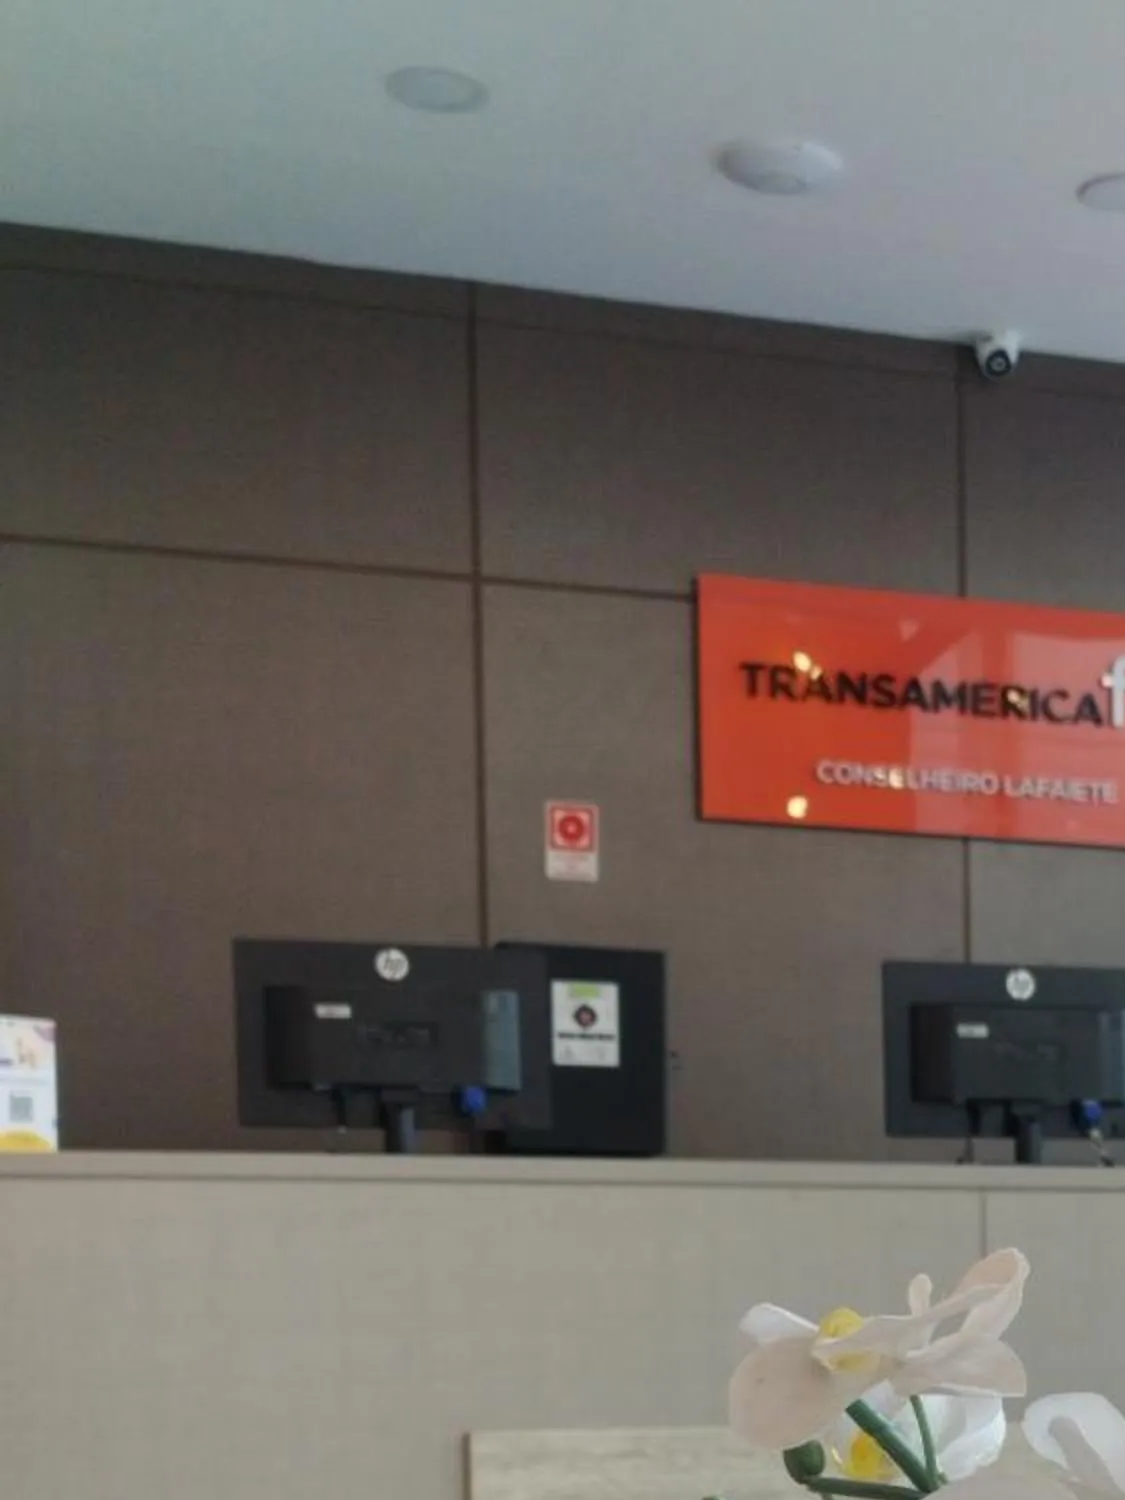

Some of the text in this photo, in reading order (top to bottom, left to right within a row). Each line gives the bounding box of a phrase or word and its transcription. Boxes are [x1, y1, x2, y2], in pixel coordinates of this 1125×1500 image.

[739, 663, 1102, 726] TRANSAMERICA
[815, 760, 1119, 805] CONSELHEIRO LAFAIETE
